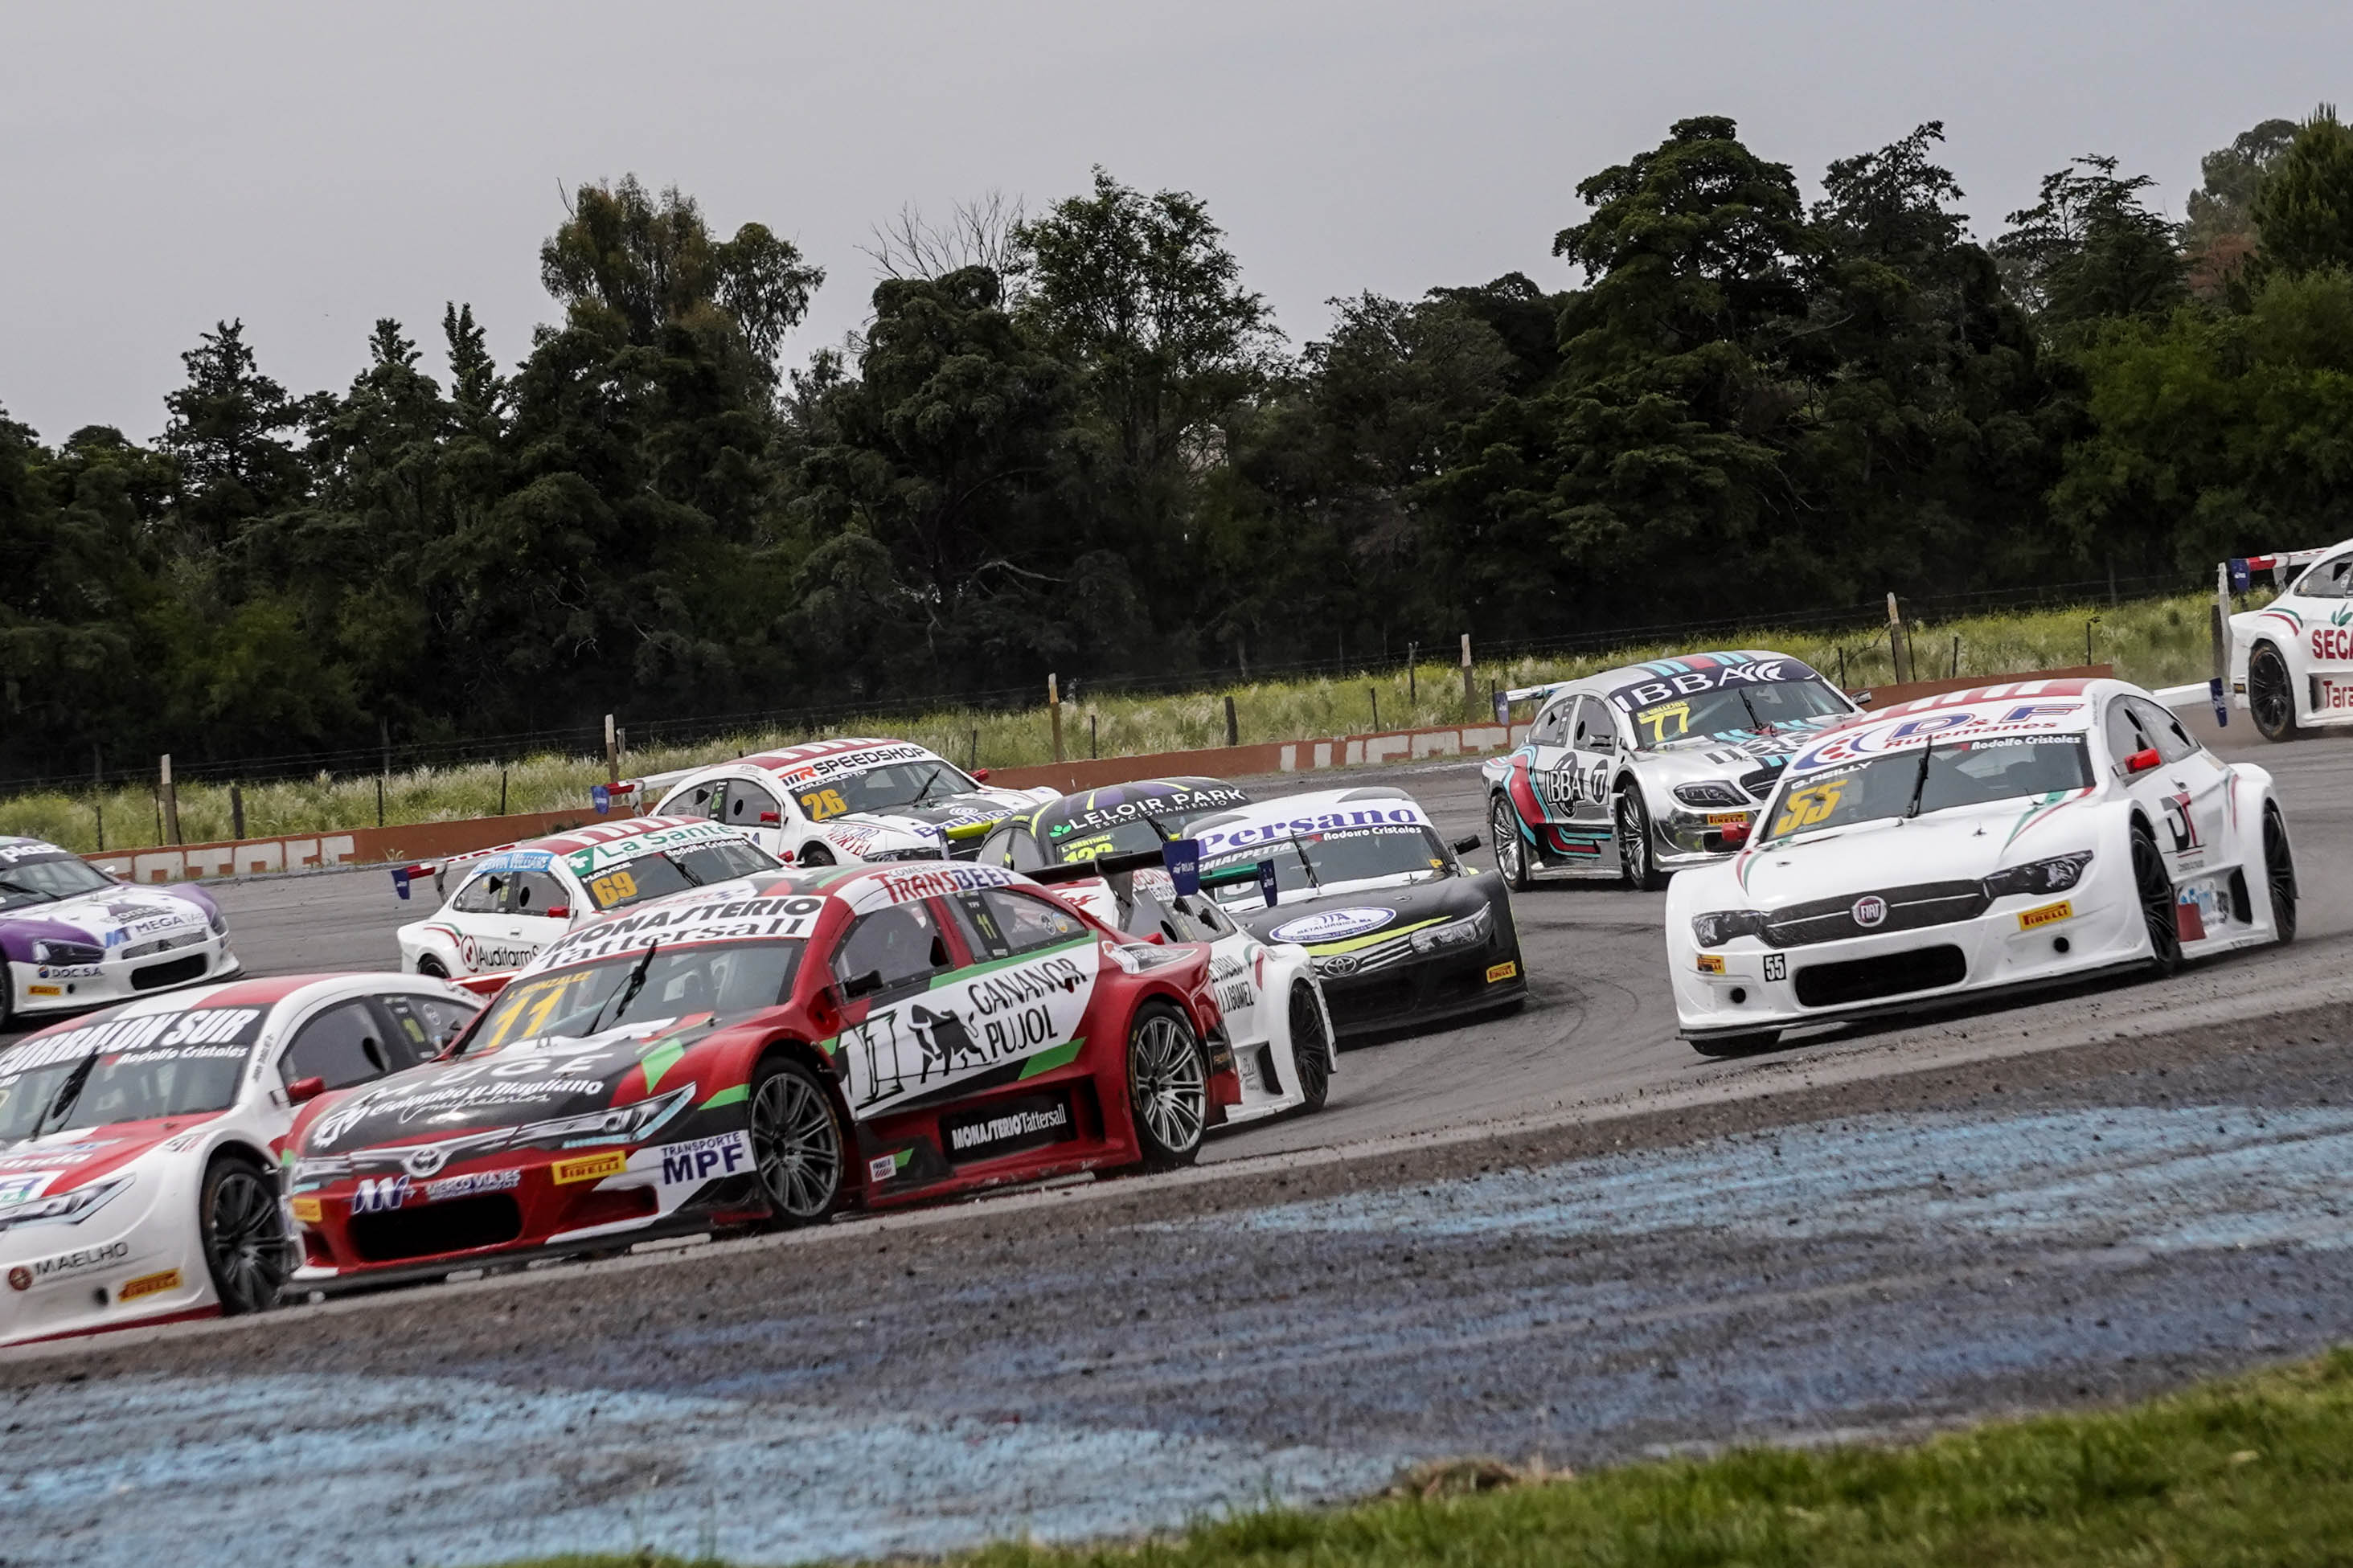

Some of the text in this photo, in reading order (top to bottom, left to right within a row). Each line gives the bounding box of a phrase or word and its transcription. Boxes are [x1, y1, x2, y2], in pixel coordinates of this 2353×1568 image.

[1638, 706, 1690, 742] 77
[1971, 735, 2081, 751] Rodolfo Cristales
[813, 747, 925, 776] SPEEDSHOP
[1545, 768, 1607, 803] IBBA 77
[801, 788, 848, 821] 26
[1068, 789, 1246, 829] LELOIR PARK
[1774, 779, 1848, 836] 55
[596, 841, 641, 858] La
[643, 825, 736, 845] Sante
[1198, 809, 1418, 858] Persano
[1371, 825, 1422, 836] Cristales
[591, 871, 637, 907] 69
[1860, 903, 1880, 919] FIAT
[2023, 904, 2068, 925] PIRELLI
[542, 919, 804, 968] Tattersall
[1766, 955, 1785, 981] 55
[161, 1009, 260, 1045] SUR
[488, 985, 567, 1048] 11
[985, 1005, 1059, 1062] PUJOL
[181, 1046, 249, 1059] Cristales
[662, 1132, 741, 1157] TRANSPORTE
[560, 1156, 620, 1179] PIRELLI
[663, 1143, 743, 1185] MPF
[35, 1242, 129, 1275] MAELHO
